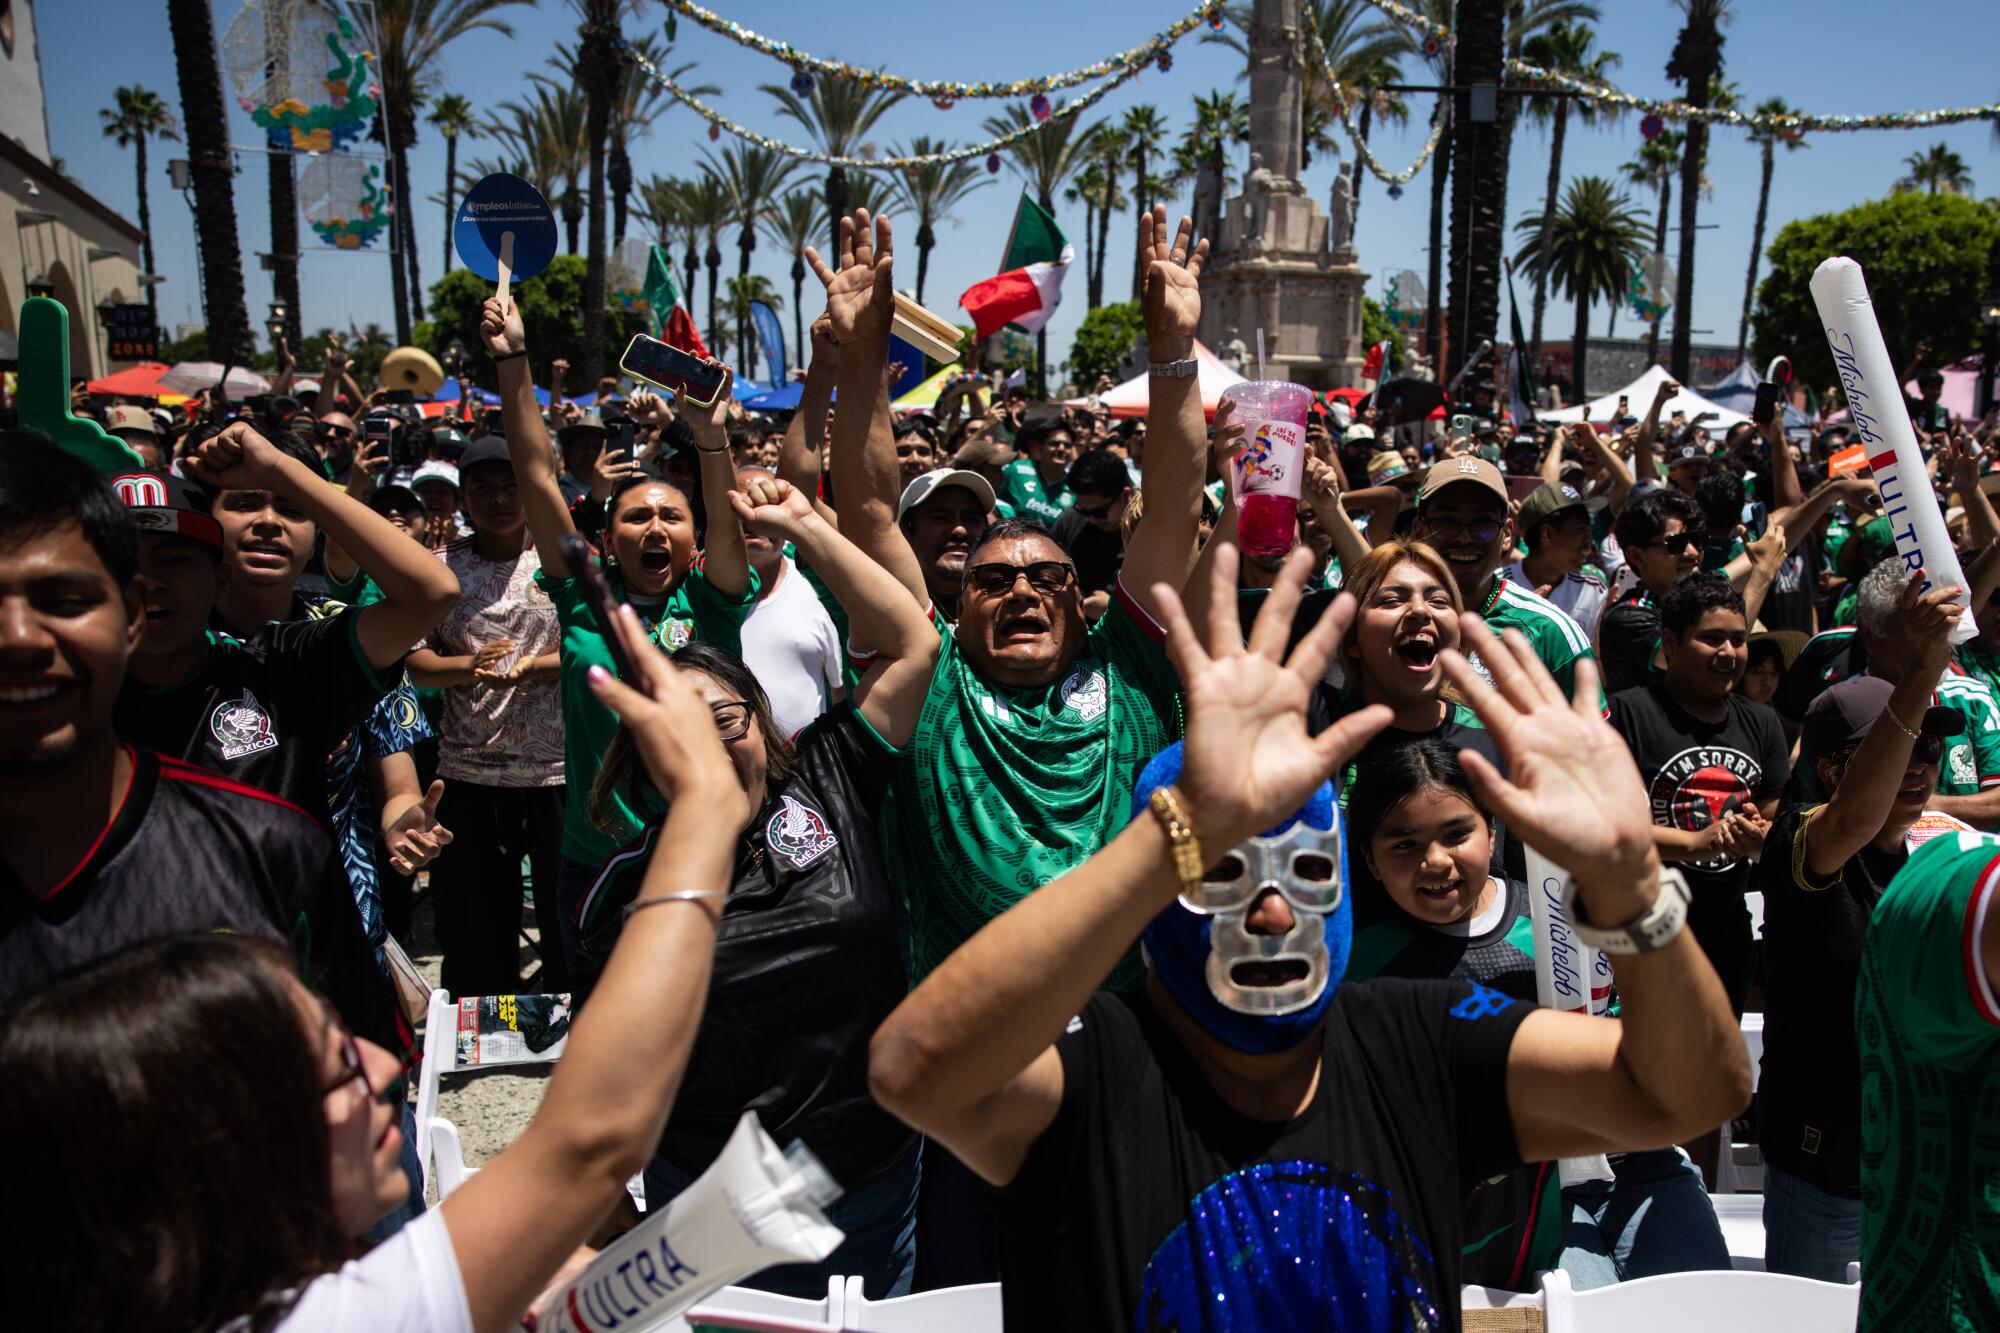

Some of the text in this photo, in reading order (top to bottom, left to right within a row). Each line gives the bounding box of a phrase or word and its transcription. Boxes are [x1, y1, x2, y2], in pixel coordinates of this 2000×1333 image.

[1828, 328, 1884, 444] Michelob
[1272, 431, 1297, 447] PUEDE!
[1457, 457, 1478, 475] LA
[1665, 755, 1696, 782] I'M
[1542, 876, 1582, 998] Michelob
[583, 1235, 699, 1329] ULTRA
